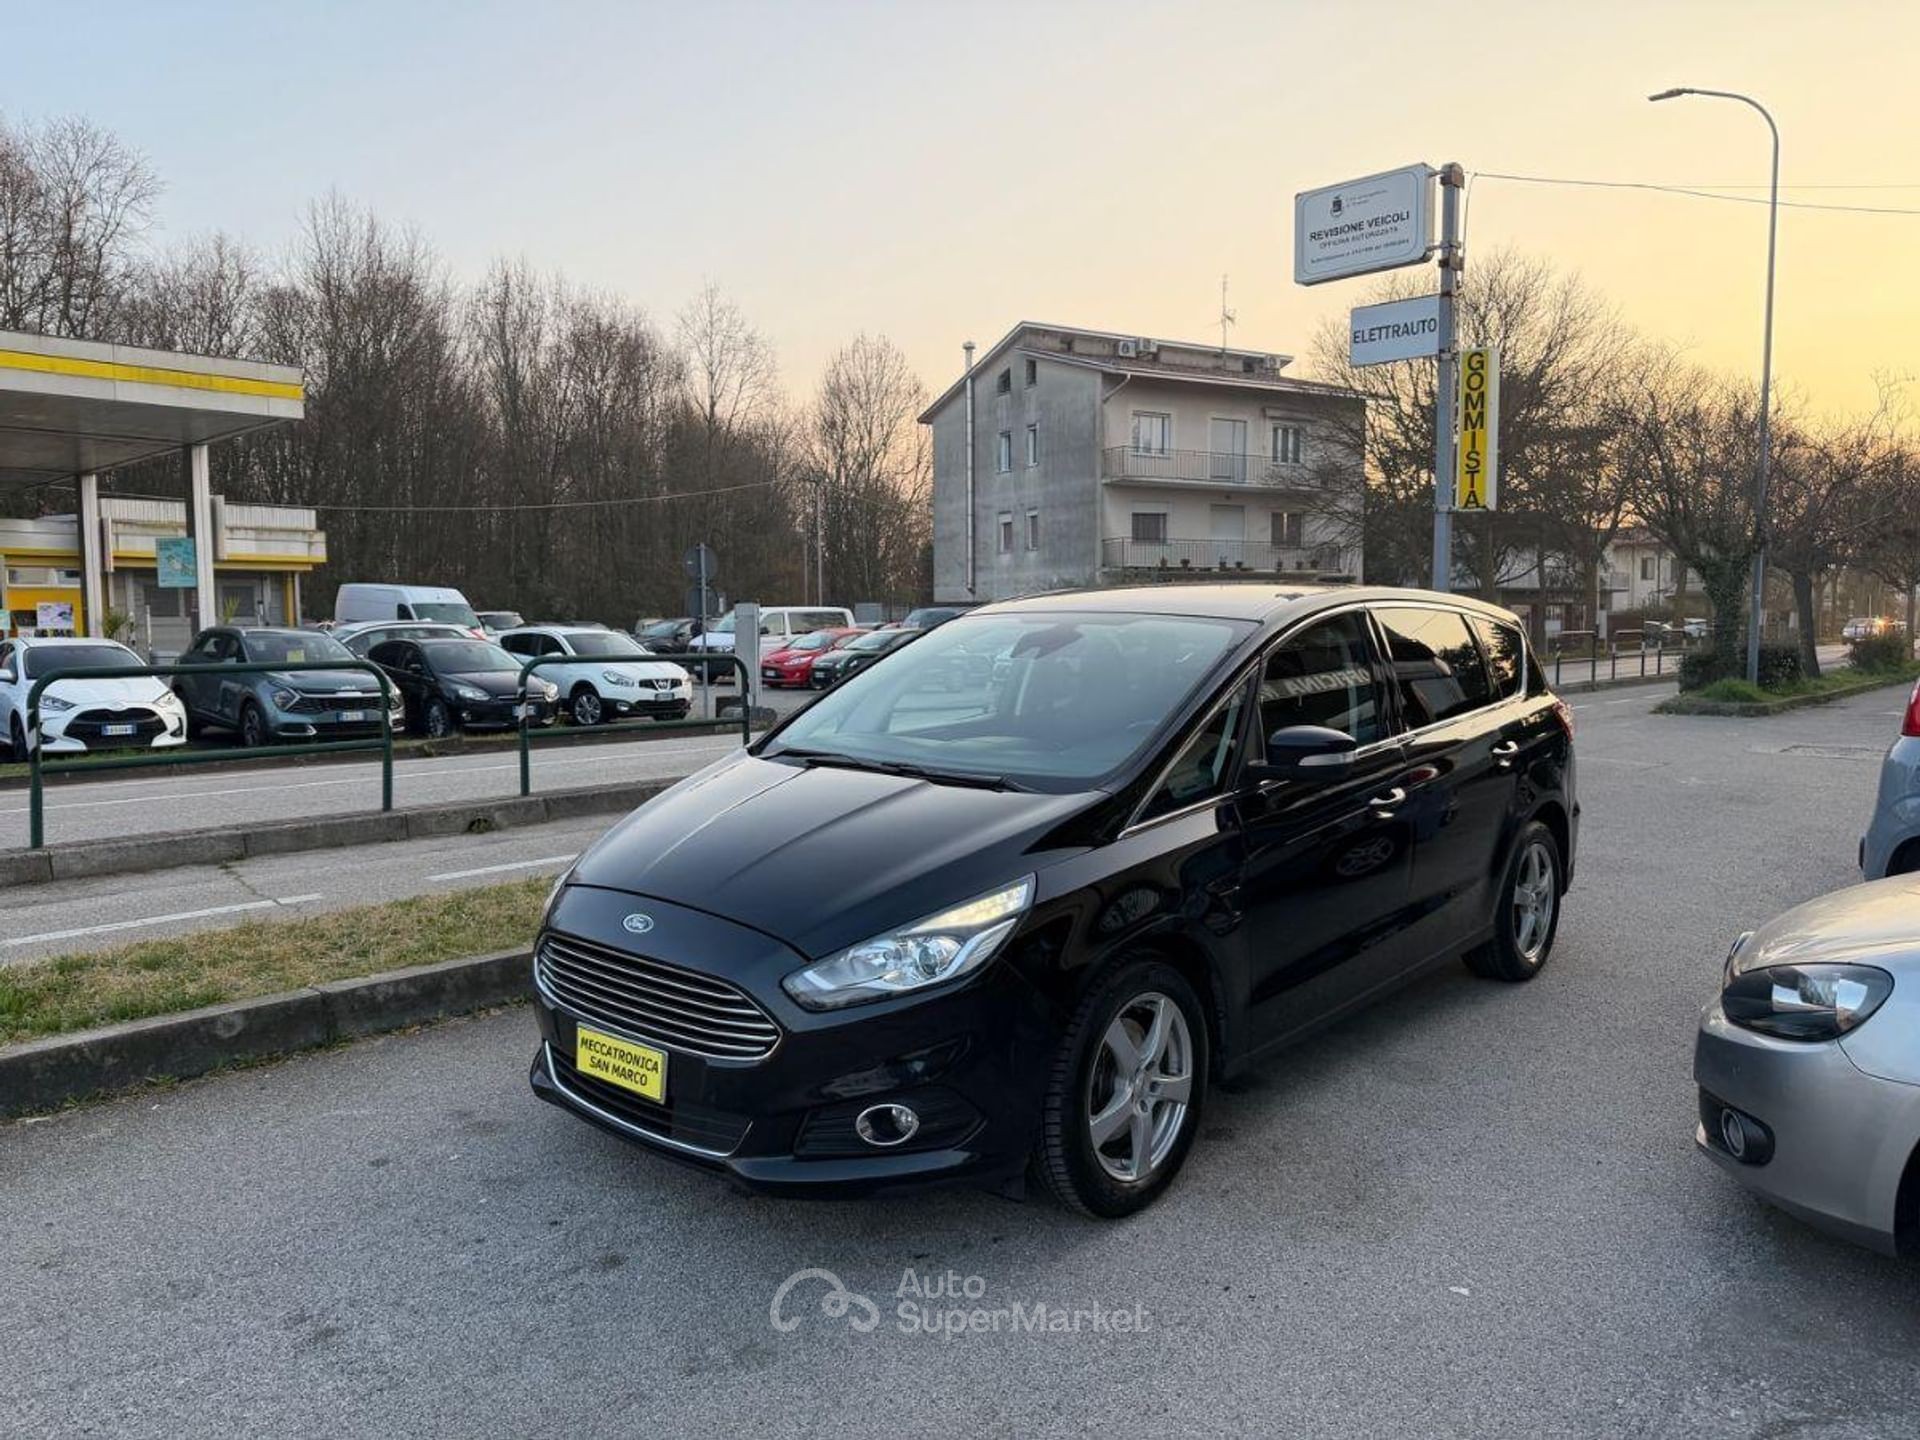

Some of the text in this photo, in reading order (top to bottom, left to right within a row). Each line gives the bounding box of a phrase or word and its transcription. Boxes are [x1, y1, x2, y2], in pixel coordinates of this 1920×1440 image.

[1309, 210, 1410, 242] REVISIONE VEICOLI
[1353, 317, 1437, 345] ELETTRAUTO
[1464, 352, 1486, 509] GOMMISTA
[580, 1037, 659, 1074] MECCATRONICA
[589, 1056, 648, 1087] SAN MARCO
